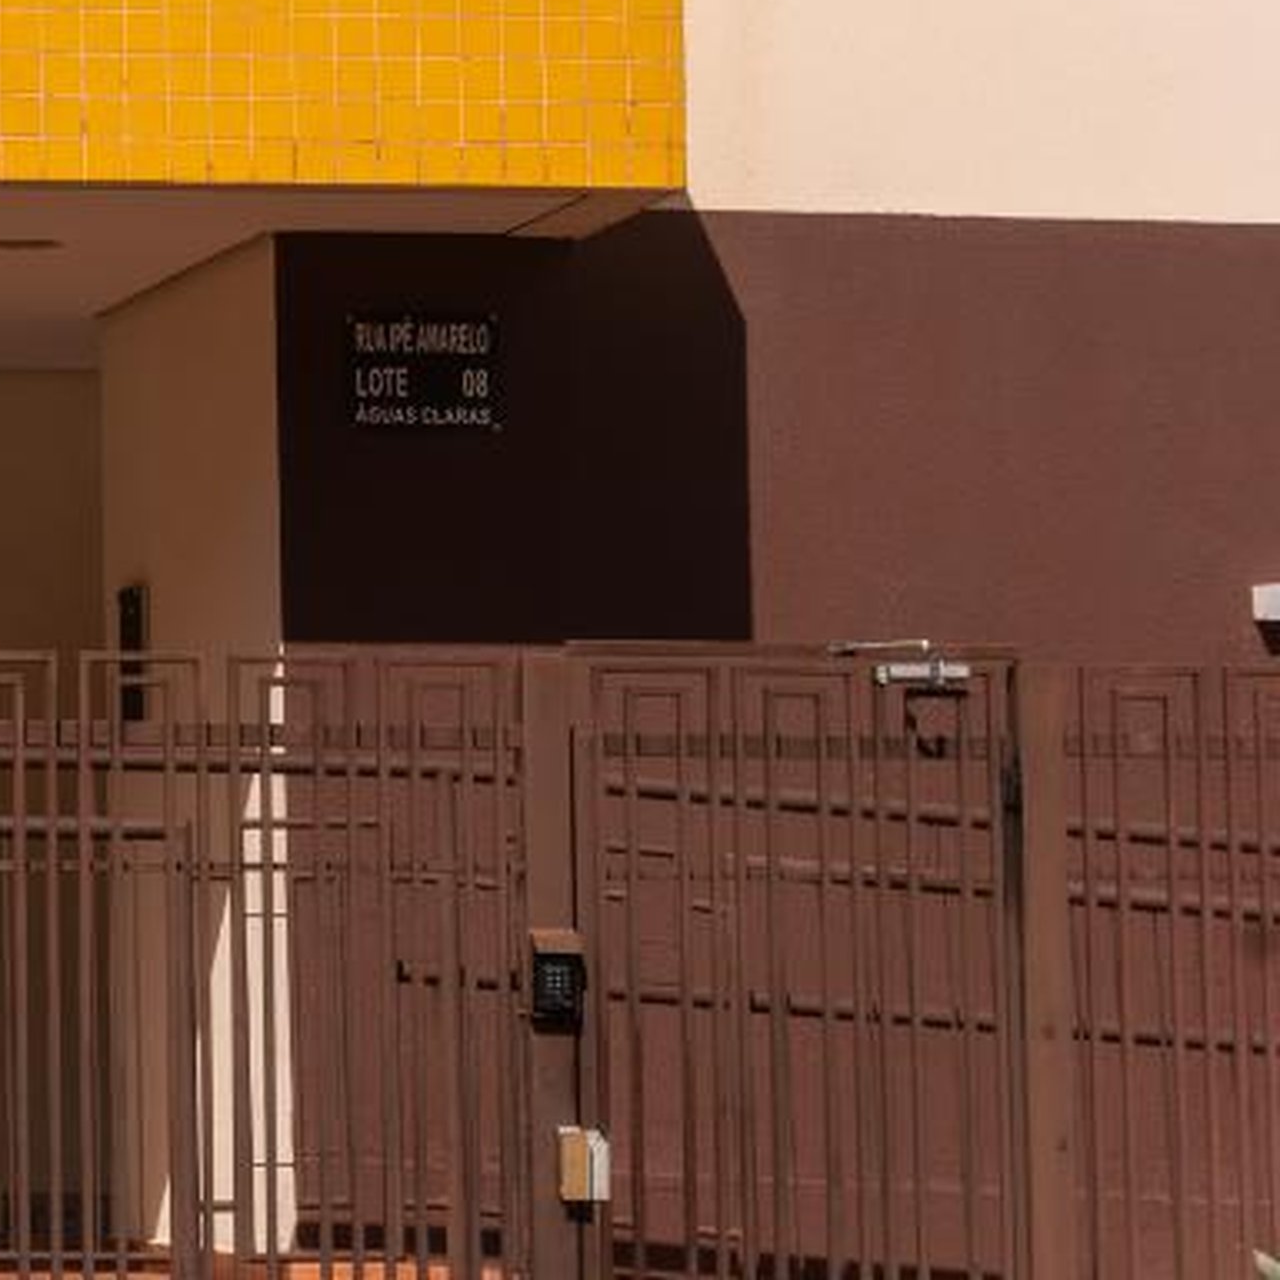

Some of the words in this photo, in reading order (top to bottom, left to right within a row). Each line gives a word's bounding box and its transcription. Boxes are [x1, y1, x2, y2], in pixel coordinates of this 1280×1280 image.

[355, 367, 409, 398] LOTE
[462, 368, 489, 398] 08
[420, 405, 491, 425] CLARAS
